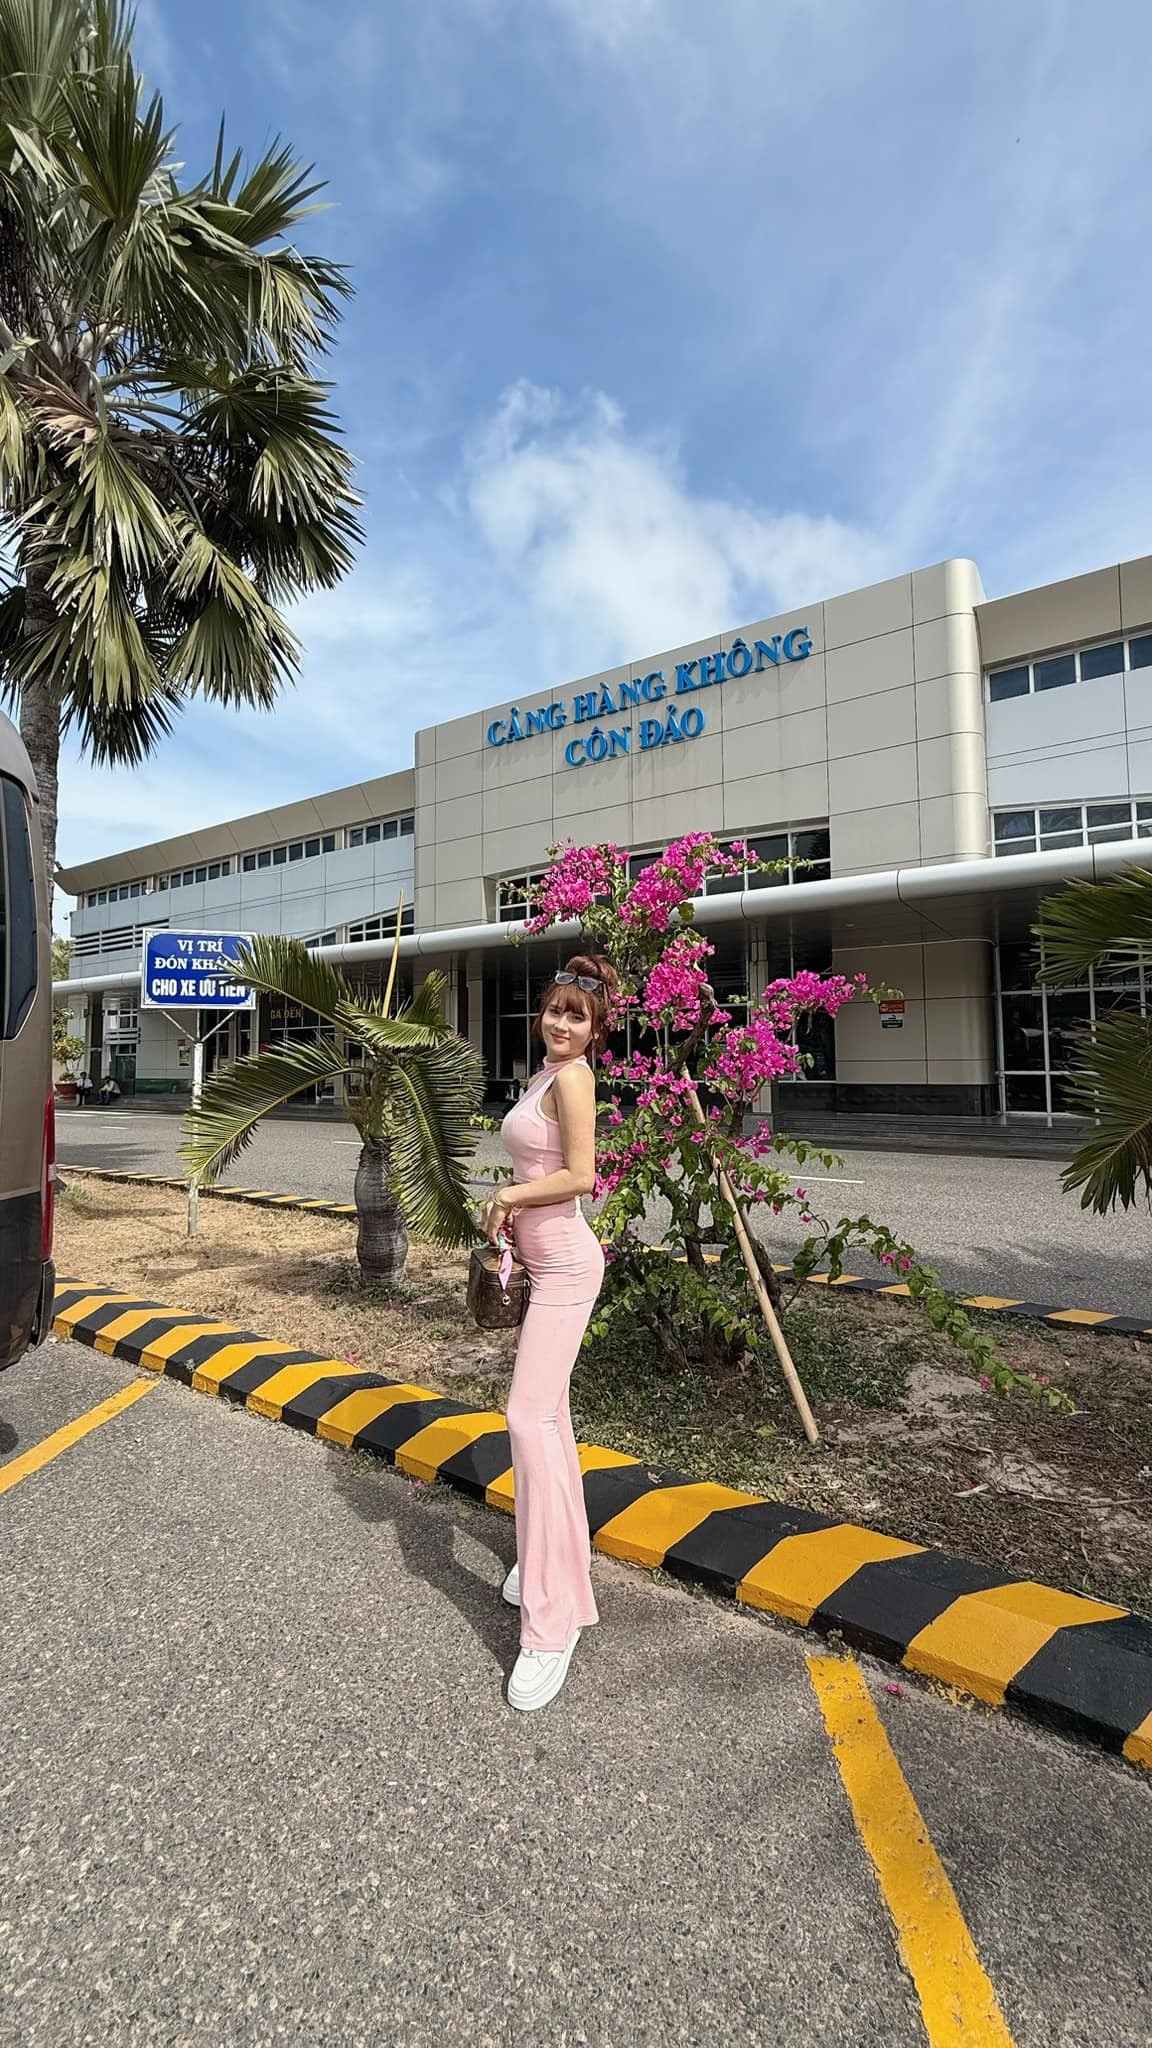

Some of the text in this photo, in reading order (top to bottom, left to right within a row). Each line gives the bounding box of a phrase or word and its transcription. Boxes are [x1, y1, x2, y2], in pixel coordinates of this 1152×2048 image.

[487, 626, 813, 746] CẢNG HÀNG KHÔNG
[565, 703, 706, 766] CÔN ĐẢO
[177, 938, 223, 955] VỊ TRÍ
[154, 954, 188, 969] ĐÓN
[152, 979, 177, 996] CHO
[180, 979, 196, 996] XE
